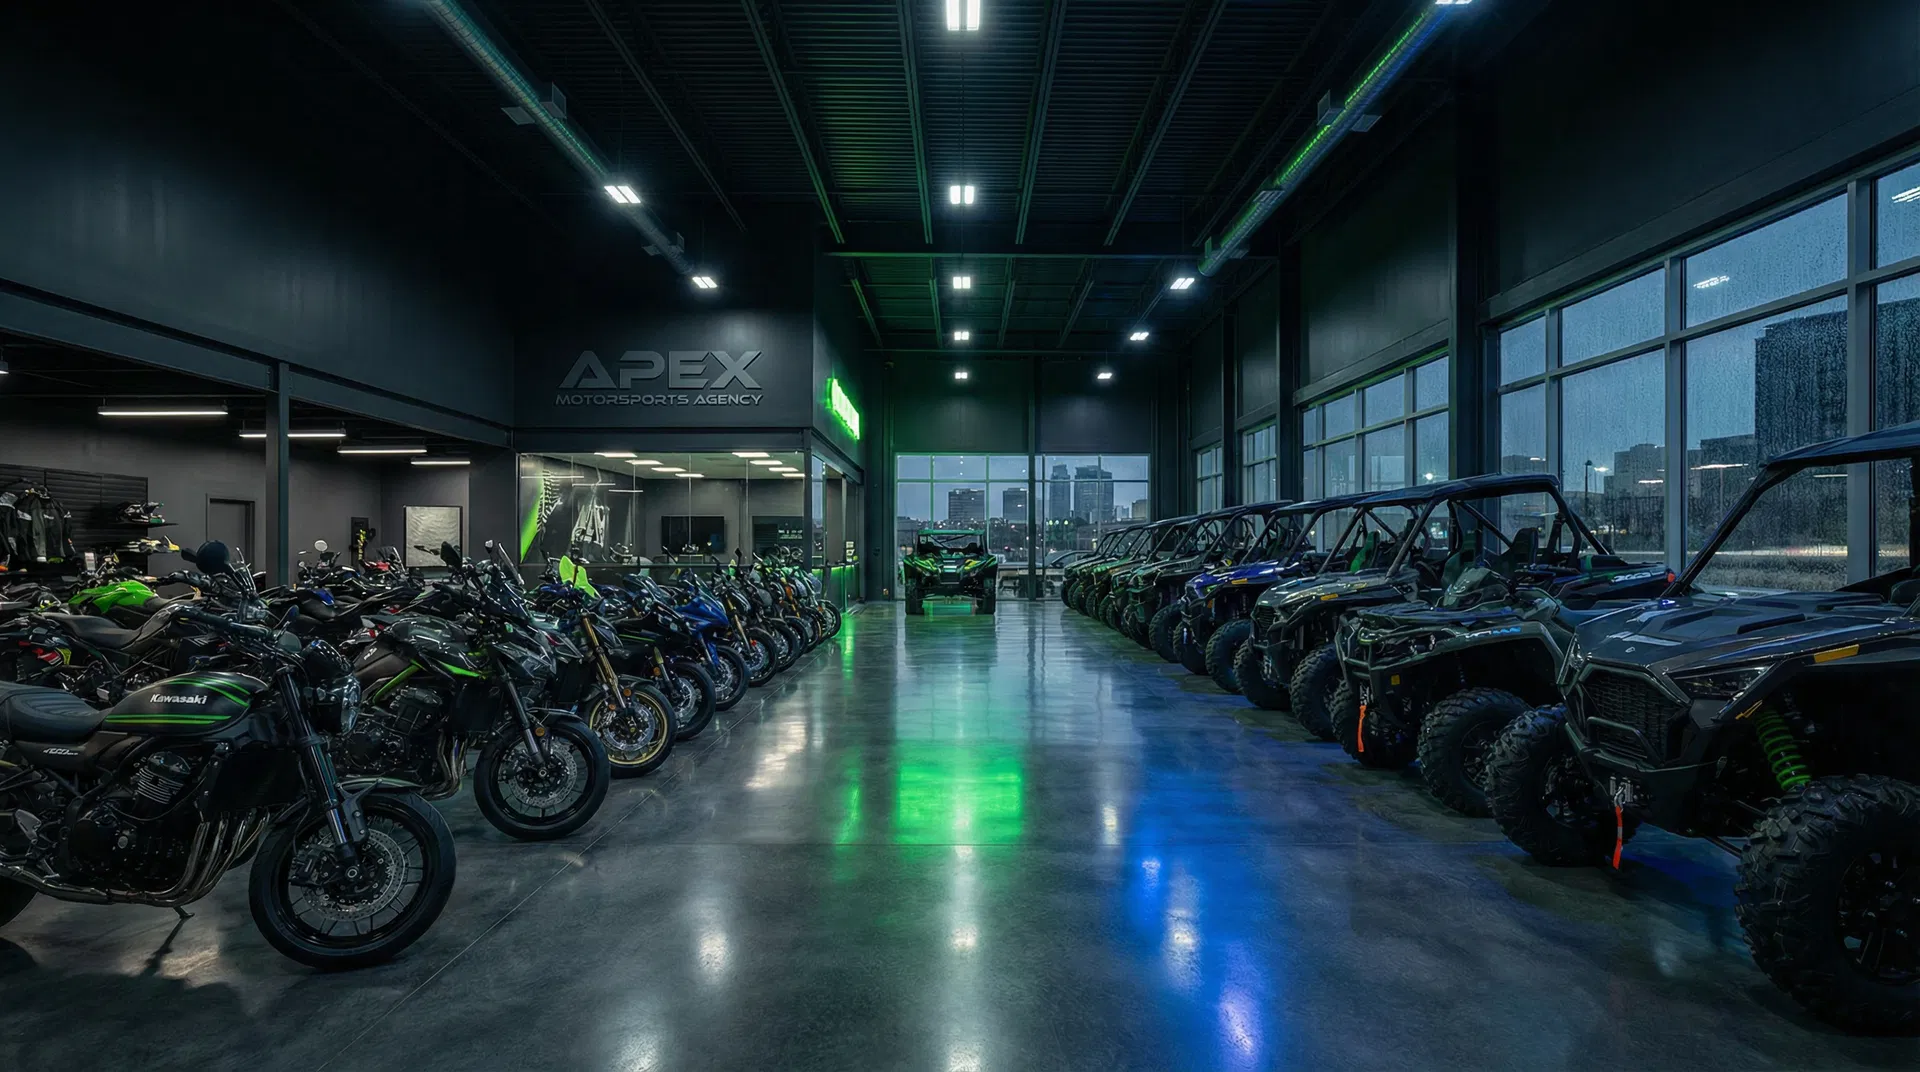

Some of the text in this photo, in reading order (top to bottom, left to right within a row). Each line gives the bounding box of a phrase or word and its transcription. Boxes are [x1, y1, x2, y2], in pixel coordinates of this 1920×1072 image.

[557, 350, 763, 388] APEX
[555, 393, 763, 406] MOTORSPORTS AGENCY
[150, 693, 208, 705] Kawasaki
